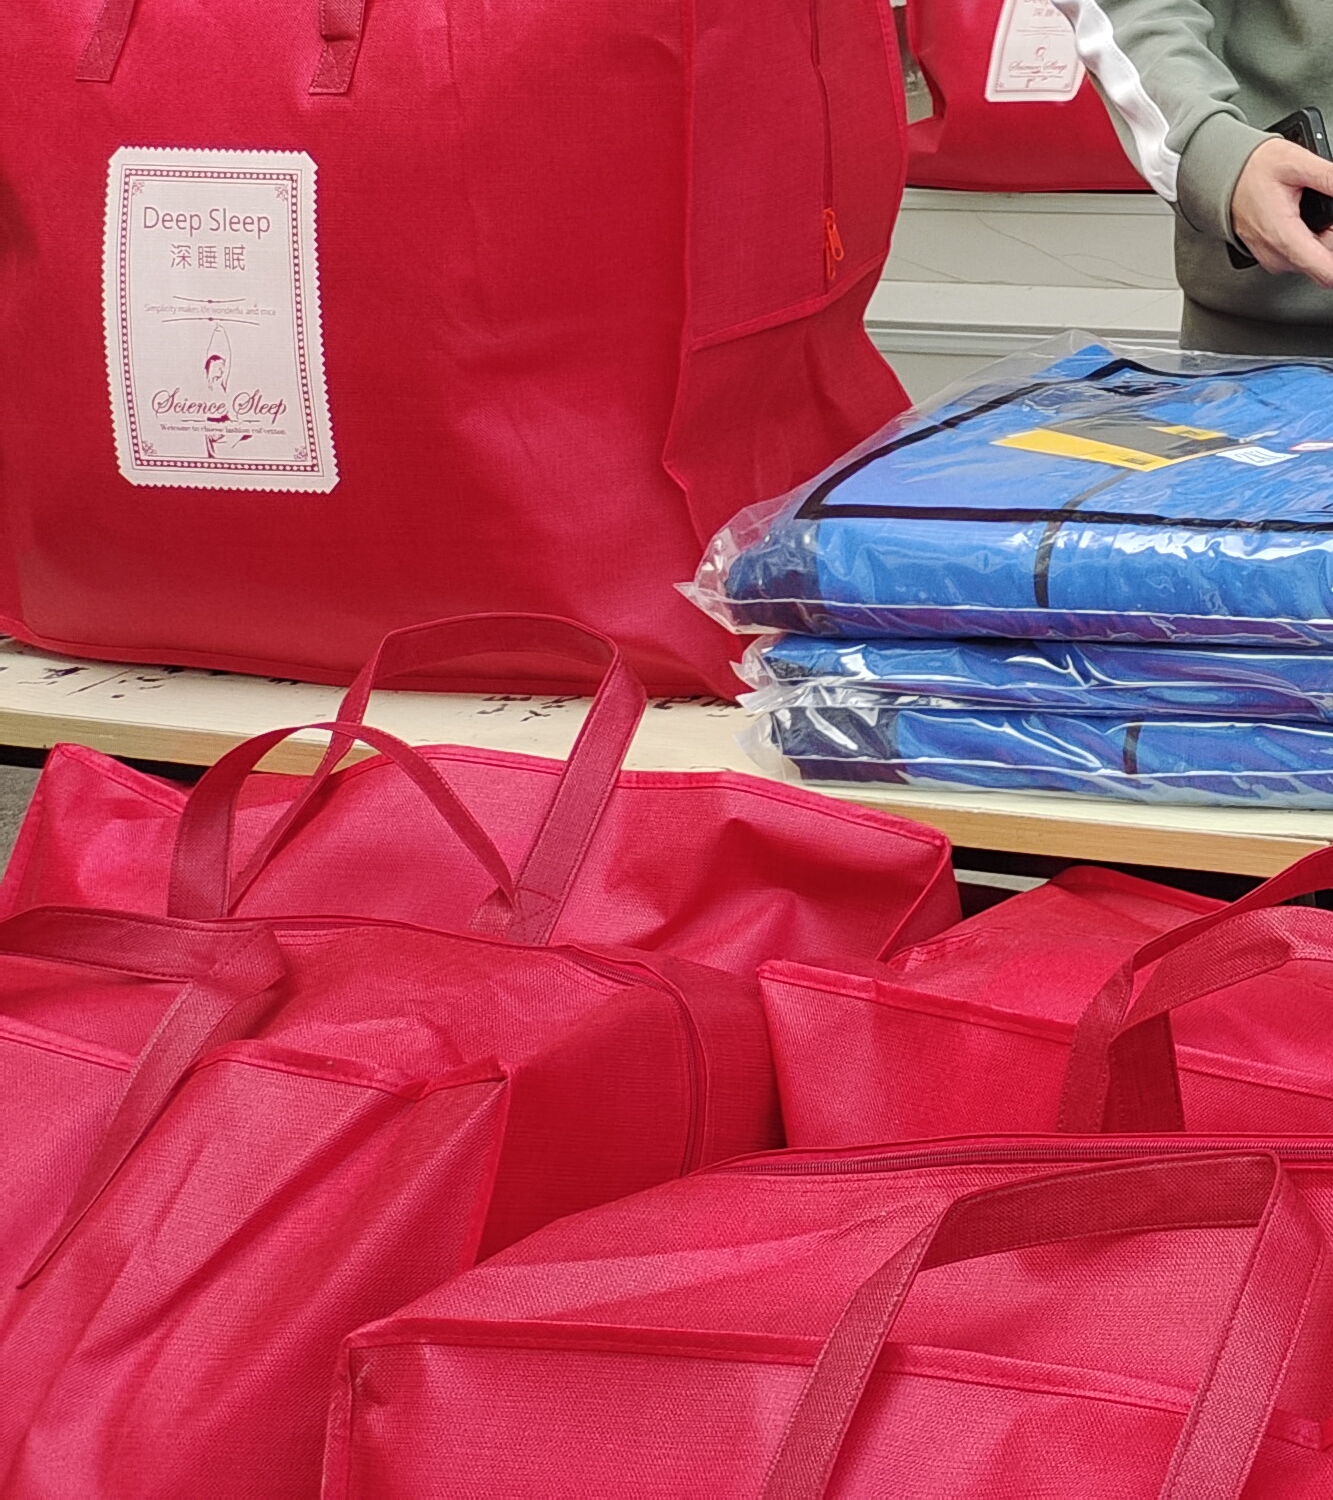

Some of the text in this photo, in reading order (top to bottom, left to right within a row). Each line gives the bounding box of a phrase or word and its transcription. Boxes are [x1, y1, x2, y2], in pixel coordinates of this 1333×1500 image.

[143, 206, 271, 241] Deep Sleep
[170, 244, 247, 271] 深睡眠
[152, 387, 287, 425] Science Sleep
